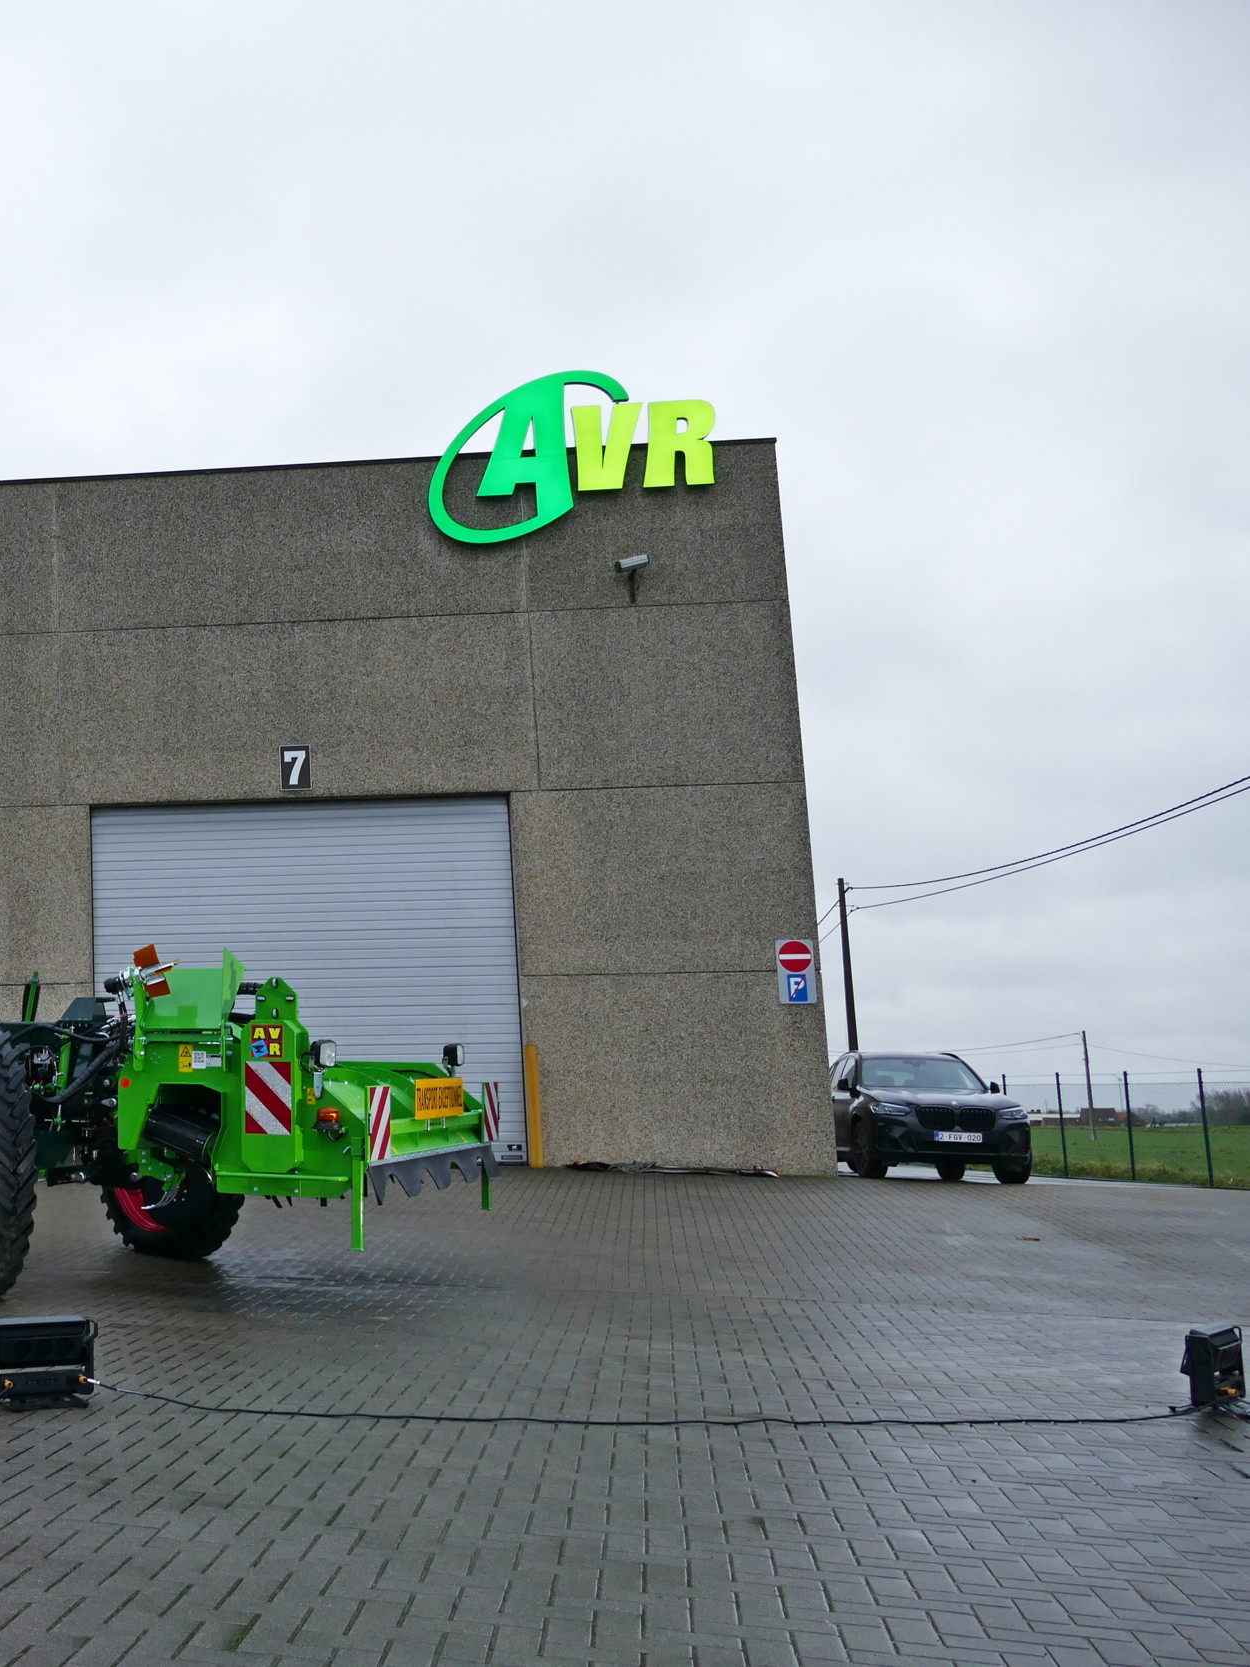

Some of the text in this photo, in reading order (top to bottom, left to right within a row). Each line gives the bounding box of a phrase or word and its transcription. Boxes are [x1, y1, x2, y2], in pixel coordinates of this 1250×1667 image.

[428, 370, 716, 544] AVR
[284, 750, 306, 785] 7
[790, 977, 805, 998] P
[416, 1085, 463, 1111] TRANSPORT EXCEPTIONNEL
